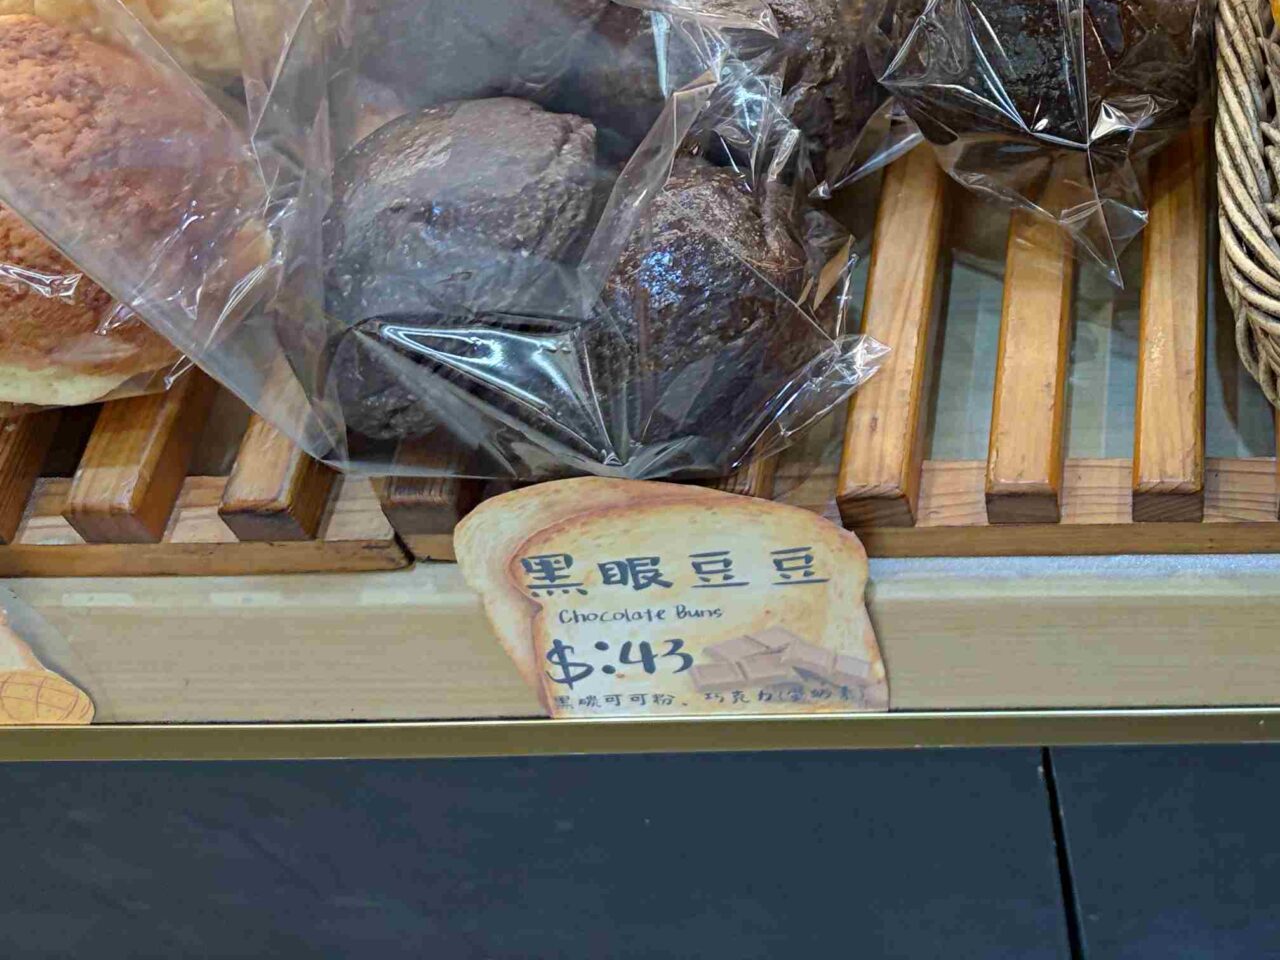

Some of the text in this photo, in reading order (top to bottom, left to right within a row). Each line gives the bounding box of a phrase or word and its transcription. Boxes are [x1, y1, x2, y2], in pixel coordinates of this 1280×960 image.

[520, 546, 829, 597] 黑眼豆豆
[558, 604, 723, 625] Chocolate Buns
